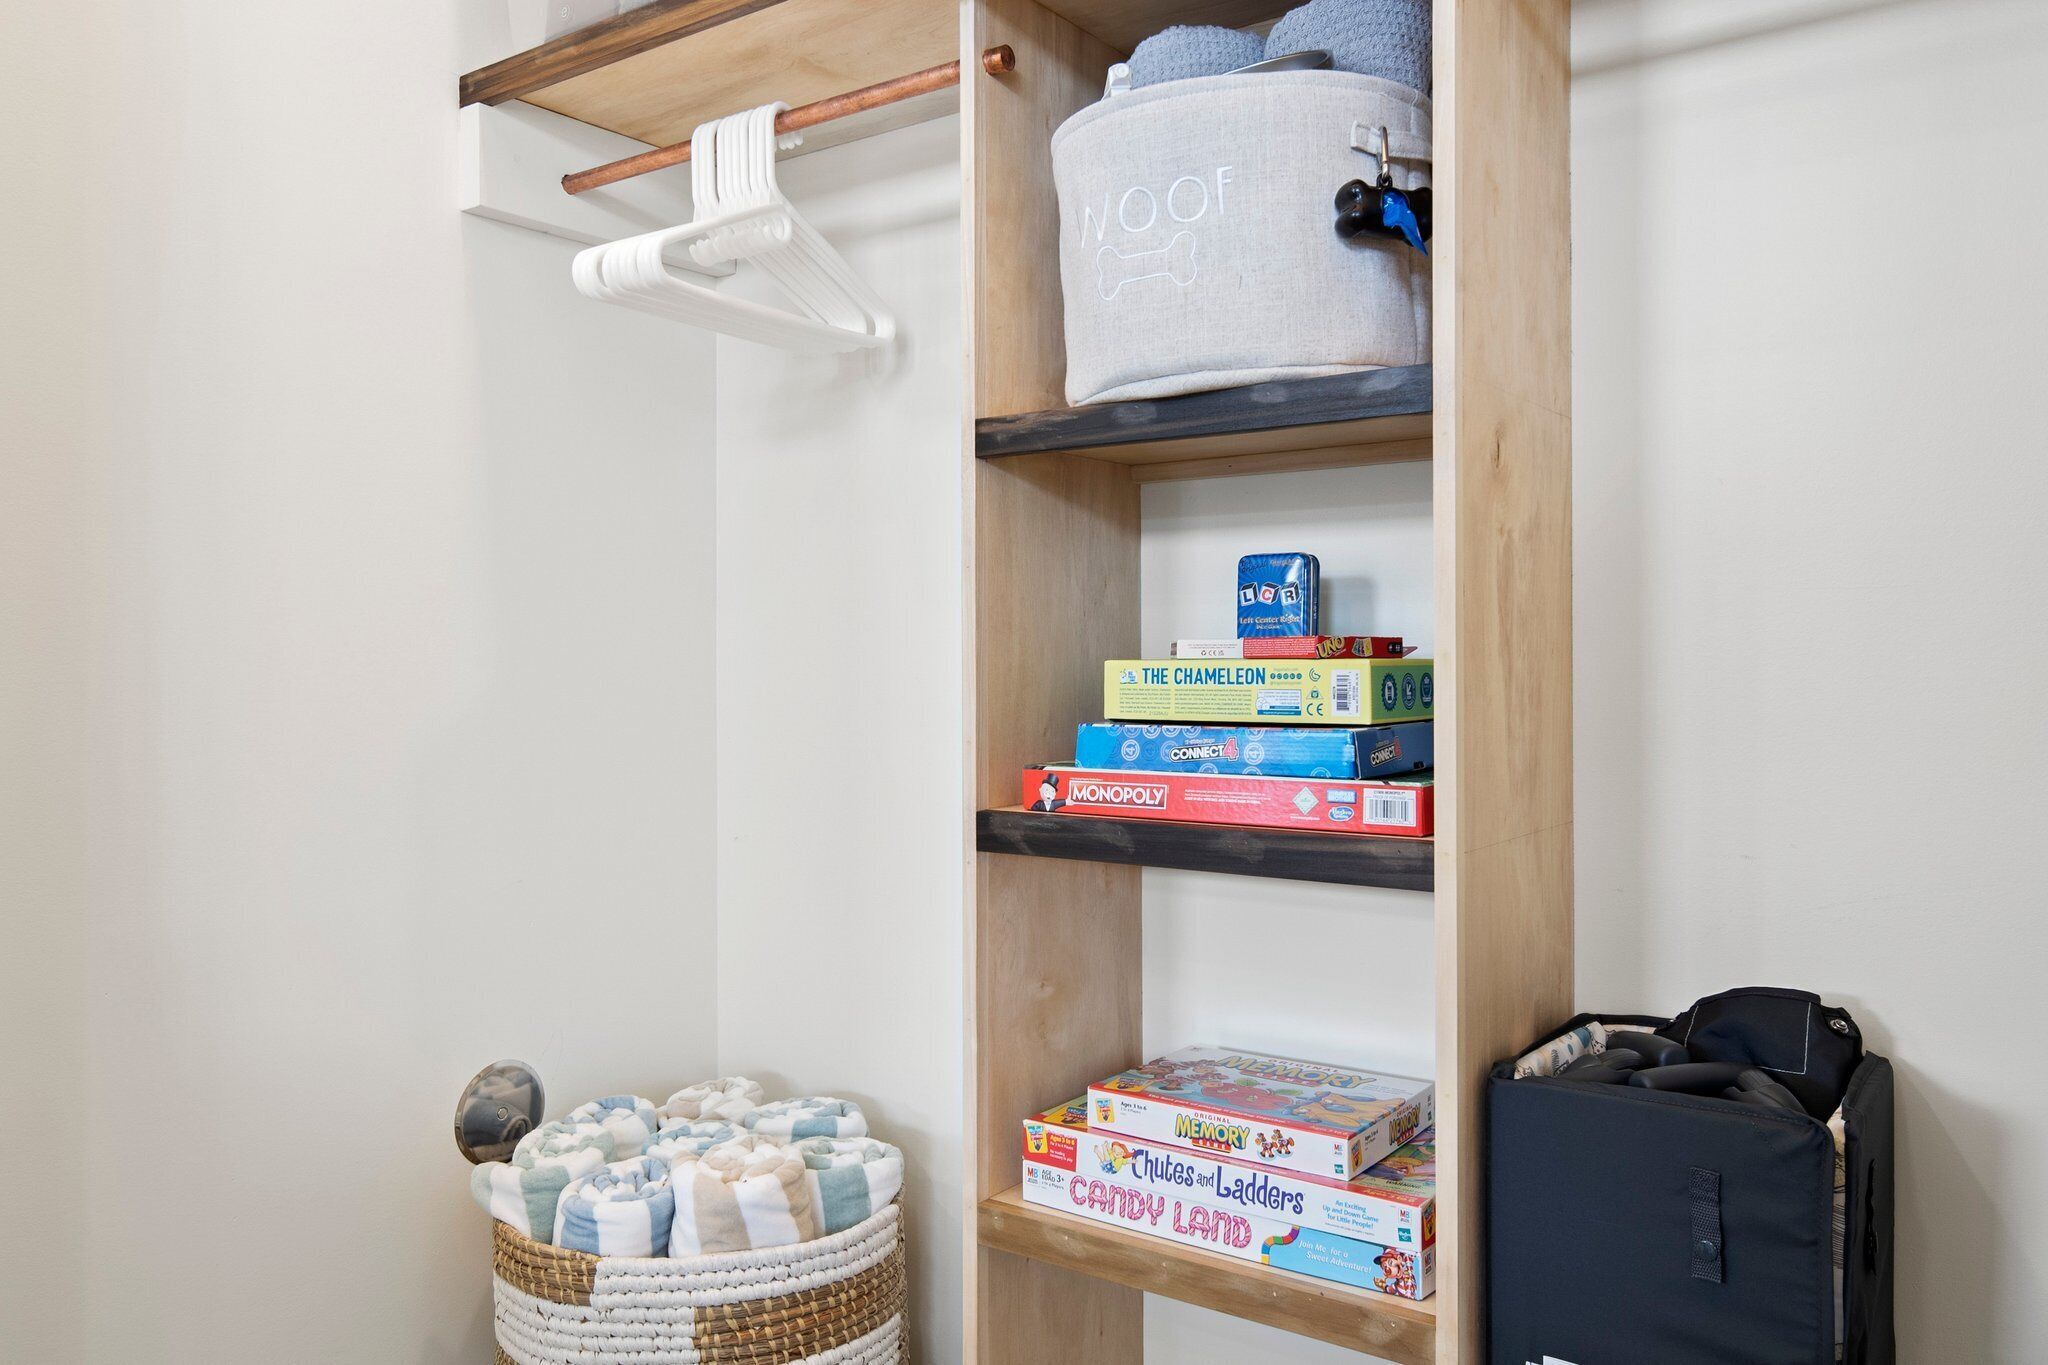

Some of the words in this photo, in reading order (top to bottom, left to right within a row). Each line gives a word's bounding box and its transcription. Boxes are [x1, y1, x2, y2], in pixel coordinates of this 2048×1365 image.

[1076, 166, 1233, 249] WOOF
[1240, 616, 1254, 624] Left
[1255, 616, 1279, 625] Center
[1279, 613, 1301, 624] Right
[1317, 636, 1345, 658] UNO
[1142, 667, 1169, 685] THE
[1174, 667, 1266, 685] CHAMELEON
[1170, 745, 1224, 761] CONNECT
[1223, 738, 1238, 759] 4
[1370, 745, 1396, 765] CONNECT
[1072, 784, 1164, 805] MONOPOLY
[1217, 1055, 1377, 1089] MEMORY
[1268, 1059, 1339, 1073] ORIGINAL
[1194, 1112, 1231, 1124] ORIGINAL
[1388, 1102, 1421, 1146] MEMORY
[1050, 1134, 1061, 1143] Ages
[1175, 1113, 1250, 1150] MEMORY
[1199, 1138, 1226, 1150] GAME
[1027, 1167, 1038, 1178] MB
[1042, 1174, 1056, 1182] EDAD
[1056, 1174, 1064, 1183] 3+
[1131, 1149, 1194, 1187] Chutes
[1196, 1172, 1215, 1188] and
[1216, 1165, 1304, 1215] Ladders
[1069, 1175, 1165, 1226] CANDY
[1172, 1201, 1252, 1248] LAND
[1323, 1204, 1331, 1213] Up
[1332, 1206, 1343, 1214] and
[1344, 1209, 1360, 1219] Down
[1362, 1213, 1379, 1223] Game
[1335, 1200, 1344, 1208] An
[1345, 1202, 1367, 1213] Exciting
[1400, 1209, 1410, 1219] MB
[1336, 1214, 1351, 1224] Little
[1352, 1218, 1373, 1229] People!
[1299, 1240, 1314, 1250] Join
[1330, 1247, 1342, 1256] for
[1306, 1251, 1328, 1263] Sweet
[1330, 1258, 1371, 1273] Adventure!
